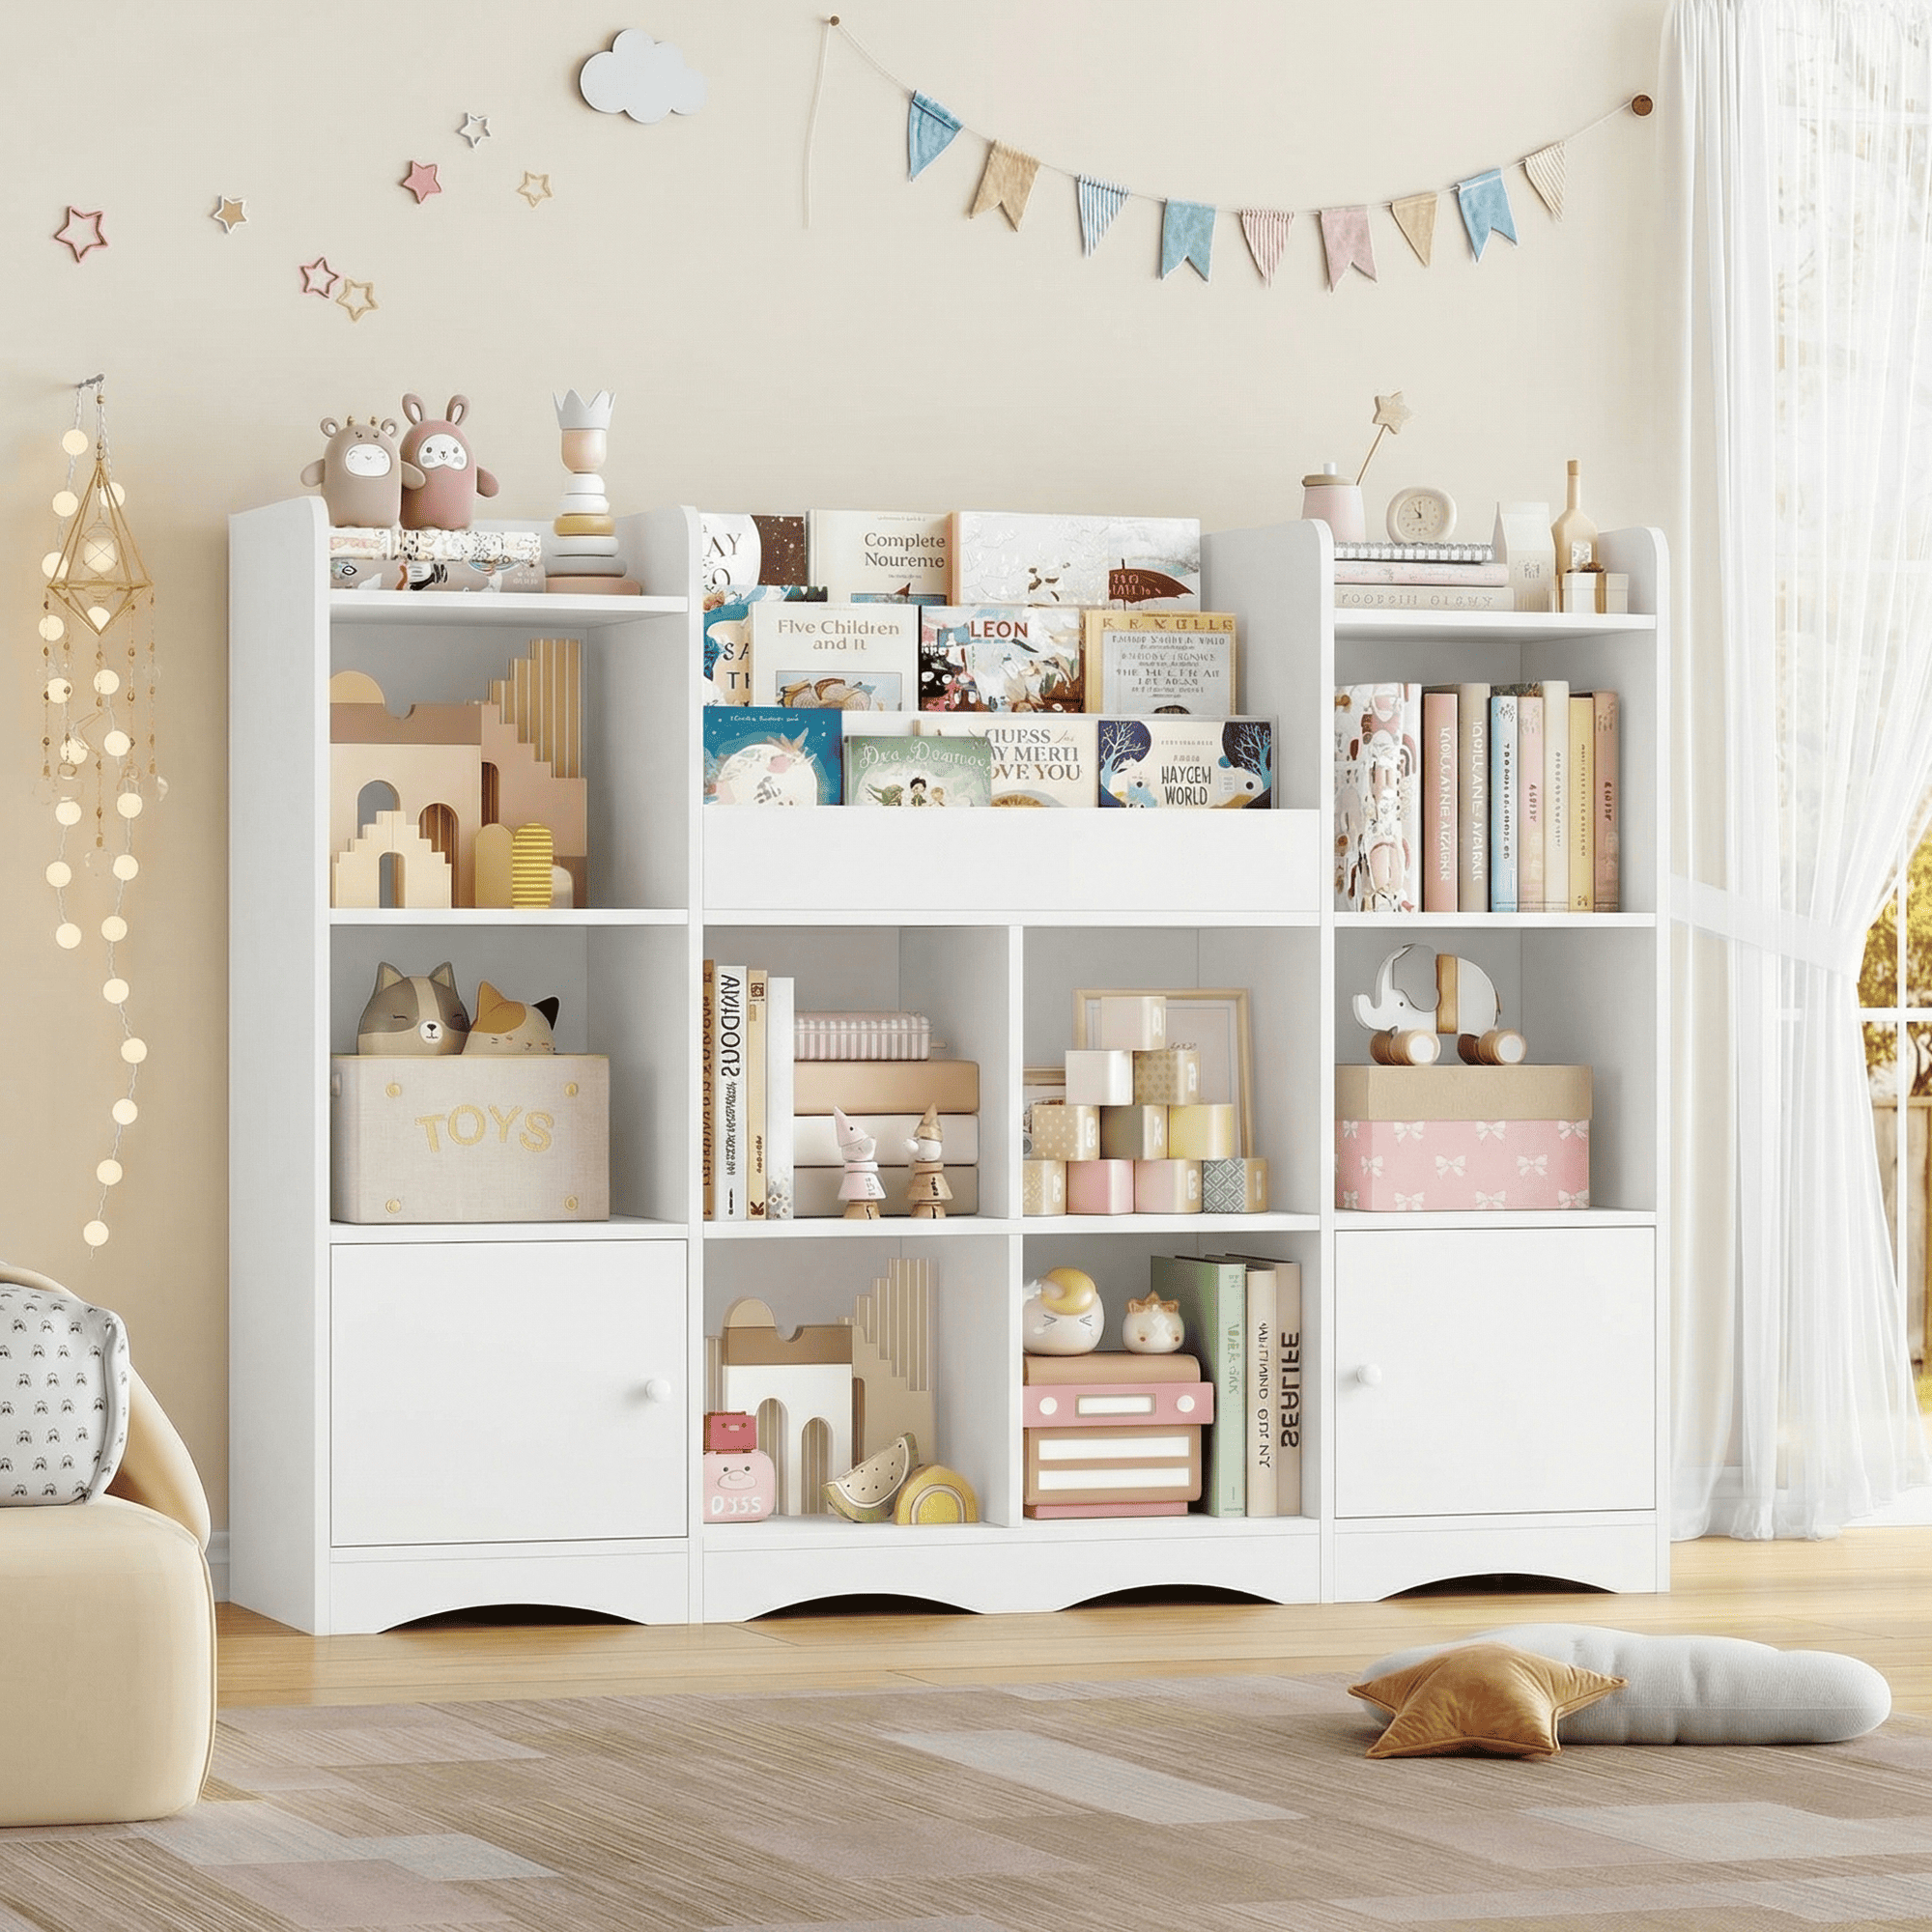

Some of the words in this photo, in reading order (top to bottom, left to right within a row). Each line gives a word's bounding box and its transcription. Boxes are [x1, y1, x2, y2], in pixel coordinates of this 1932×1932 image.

[865, 532, 946, 552] Complete
[820, 619, 899, 635] Children
[970, 620, 1028, 638] LEON
[812, 637, 847, 650] and
[1035, 764, 1081, 781] YOU
[1165, 786, 1208, 806] WORLD
[415, 1104, 554, 1153] TOYS
